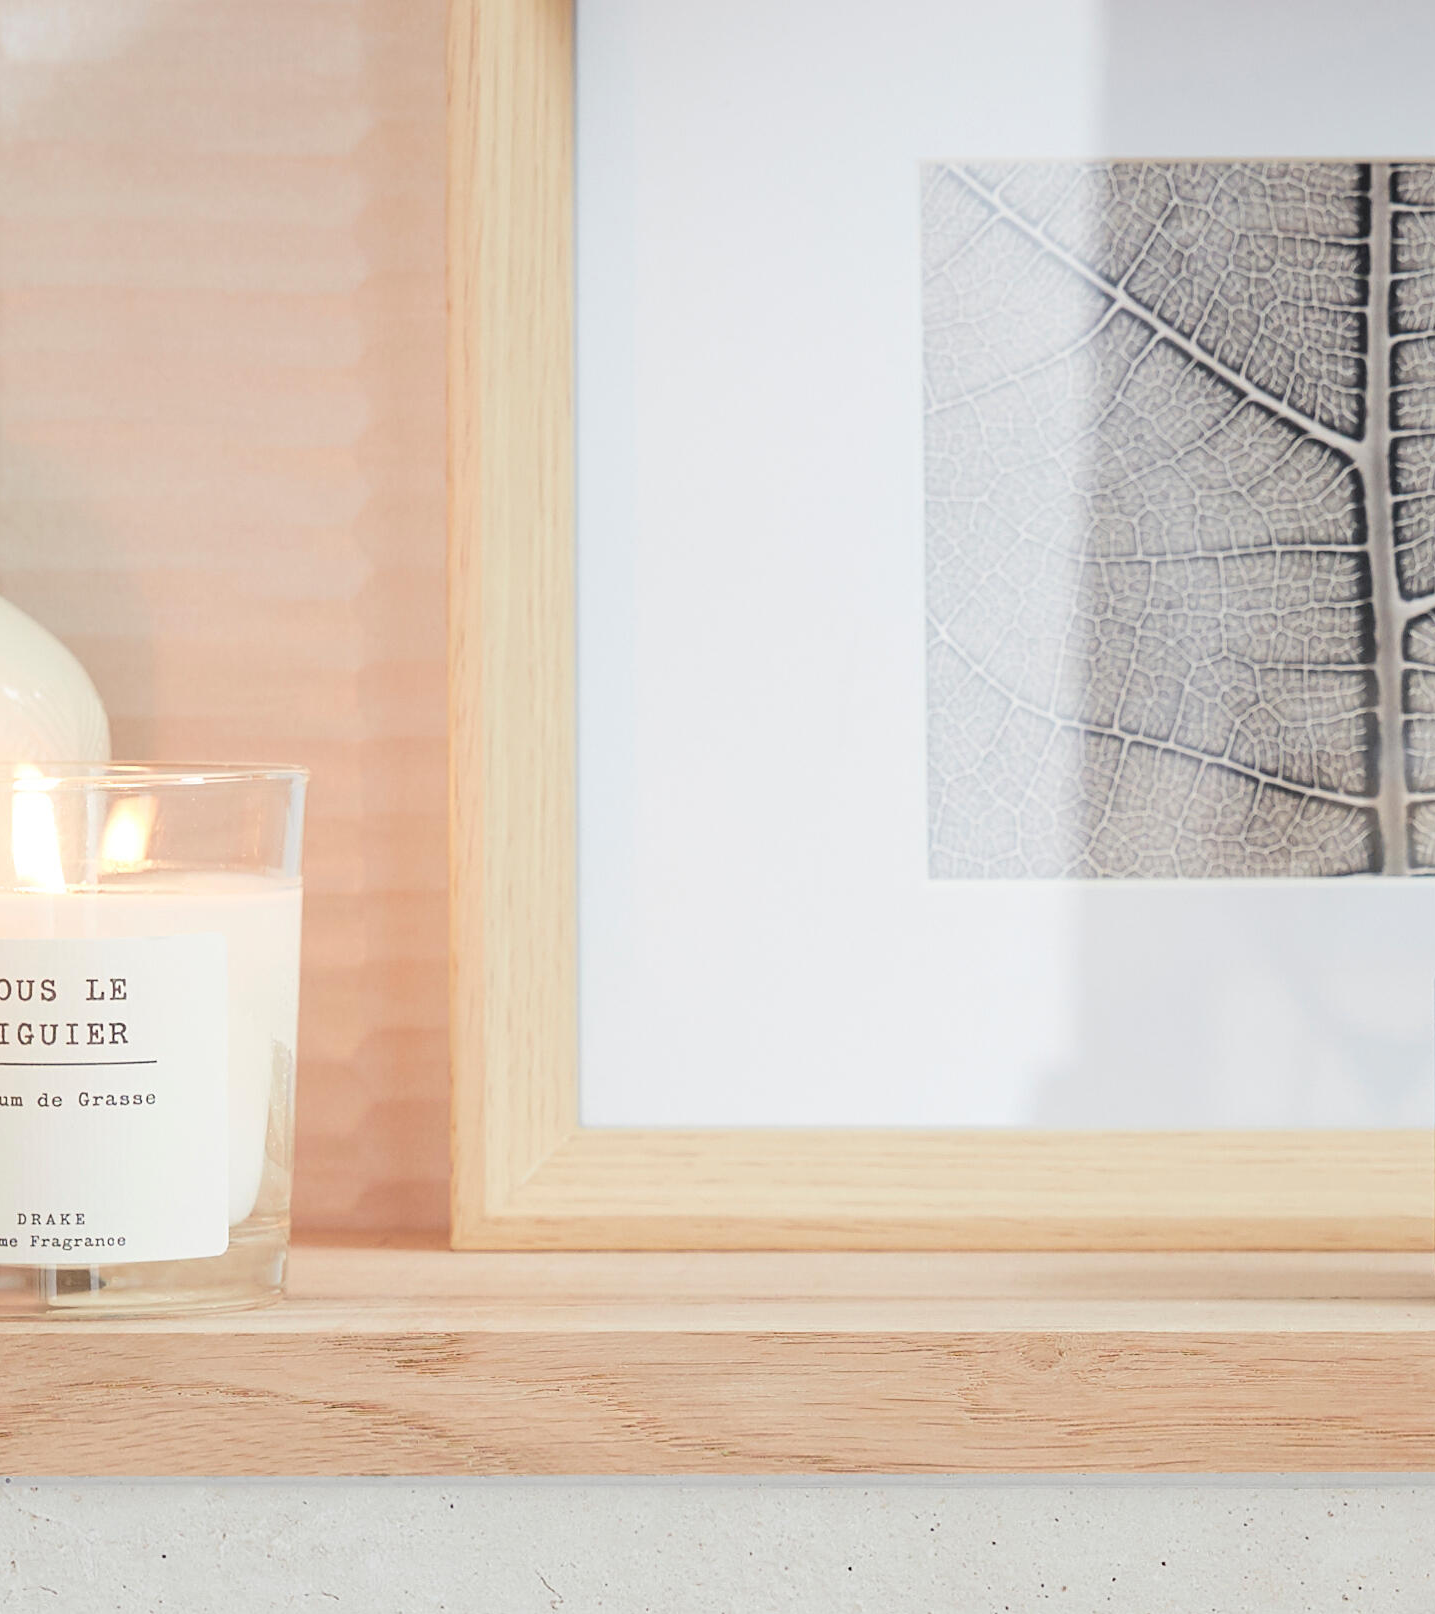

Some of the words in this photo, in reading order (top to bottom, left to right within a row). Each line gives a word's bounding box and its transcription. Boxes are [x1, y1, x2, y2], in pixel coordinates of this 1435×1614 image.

[85, 978, 127, 1001] LE
[37, 1092, 63, 1108] de
[78, 1091, 156, 1107] Grasse
[16, 1212, 86, 1226] DRAKE
[29, 1234, 126, 1251] Fragrance
